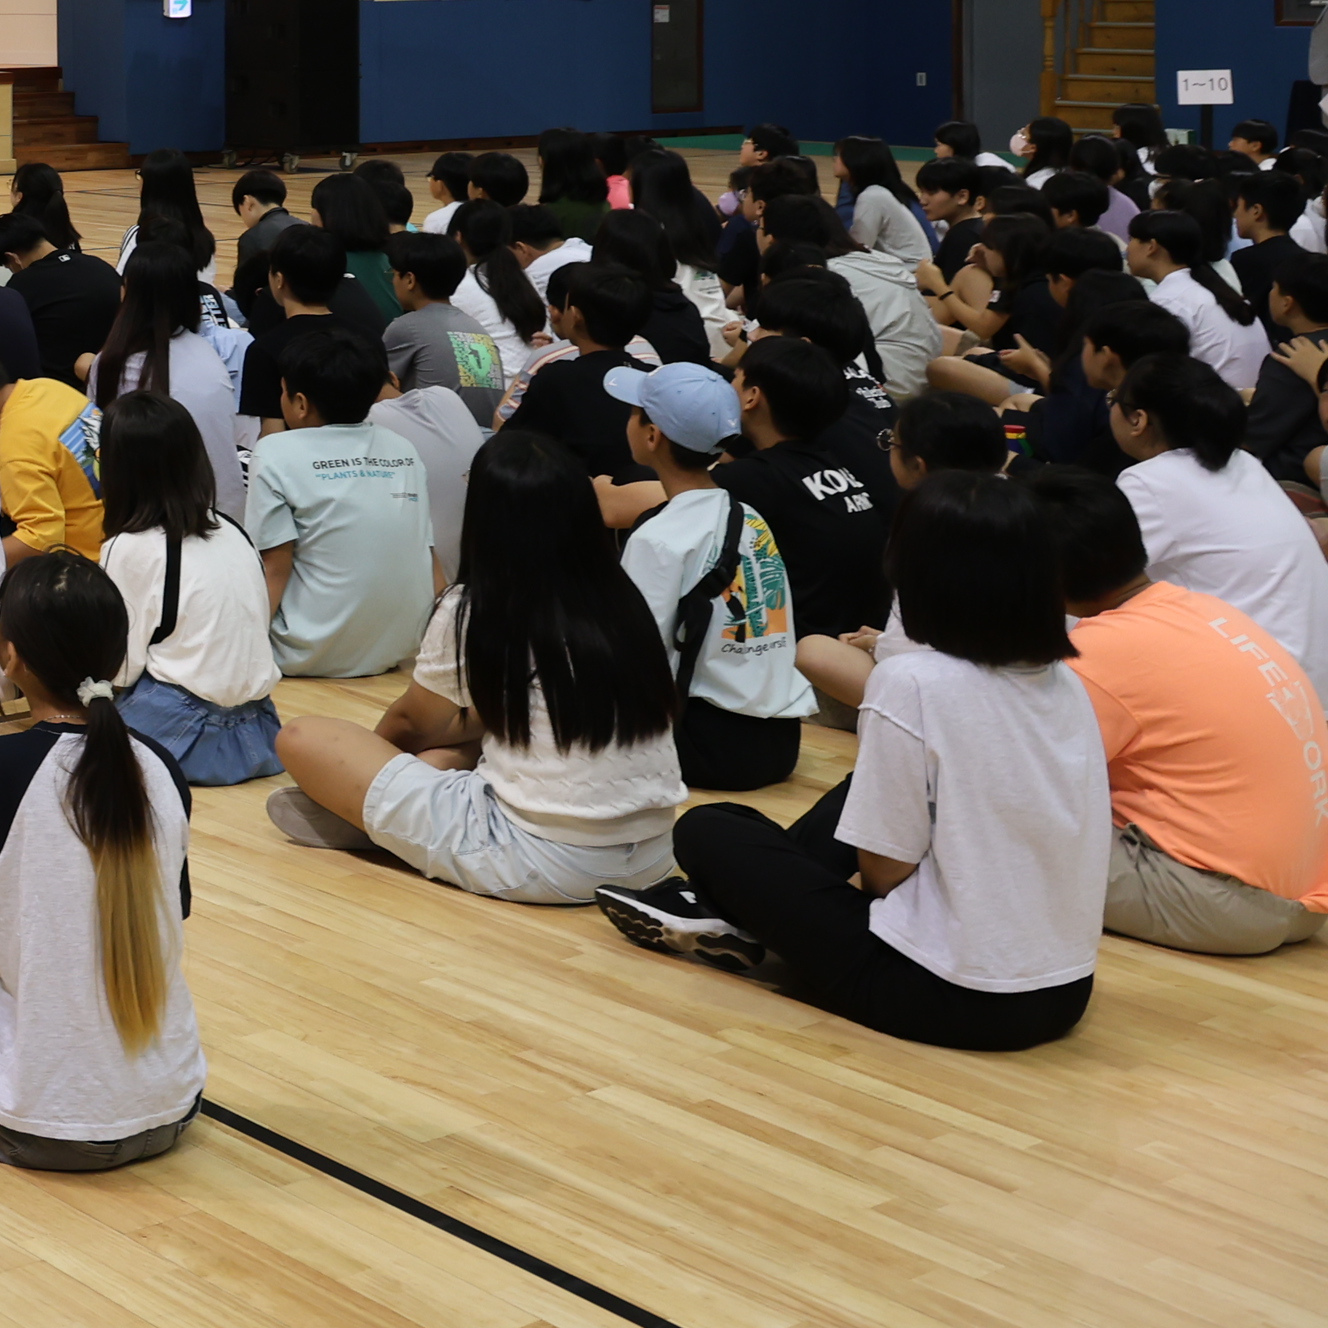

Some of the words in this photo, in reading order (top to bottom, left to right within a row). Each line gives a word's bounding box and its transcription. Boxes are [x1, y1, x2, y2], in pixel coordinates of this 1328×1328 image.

[312, 458, 350, 470] GREEN
[351, 457, 362, 467] IS
[363, 457, 379, 467] THE
[379, 458, 404, 468] COLOR
[404, 458, 415, 467] OF
[1208, 616, 1289, 687] LIFE
